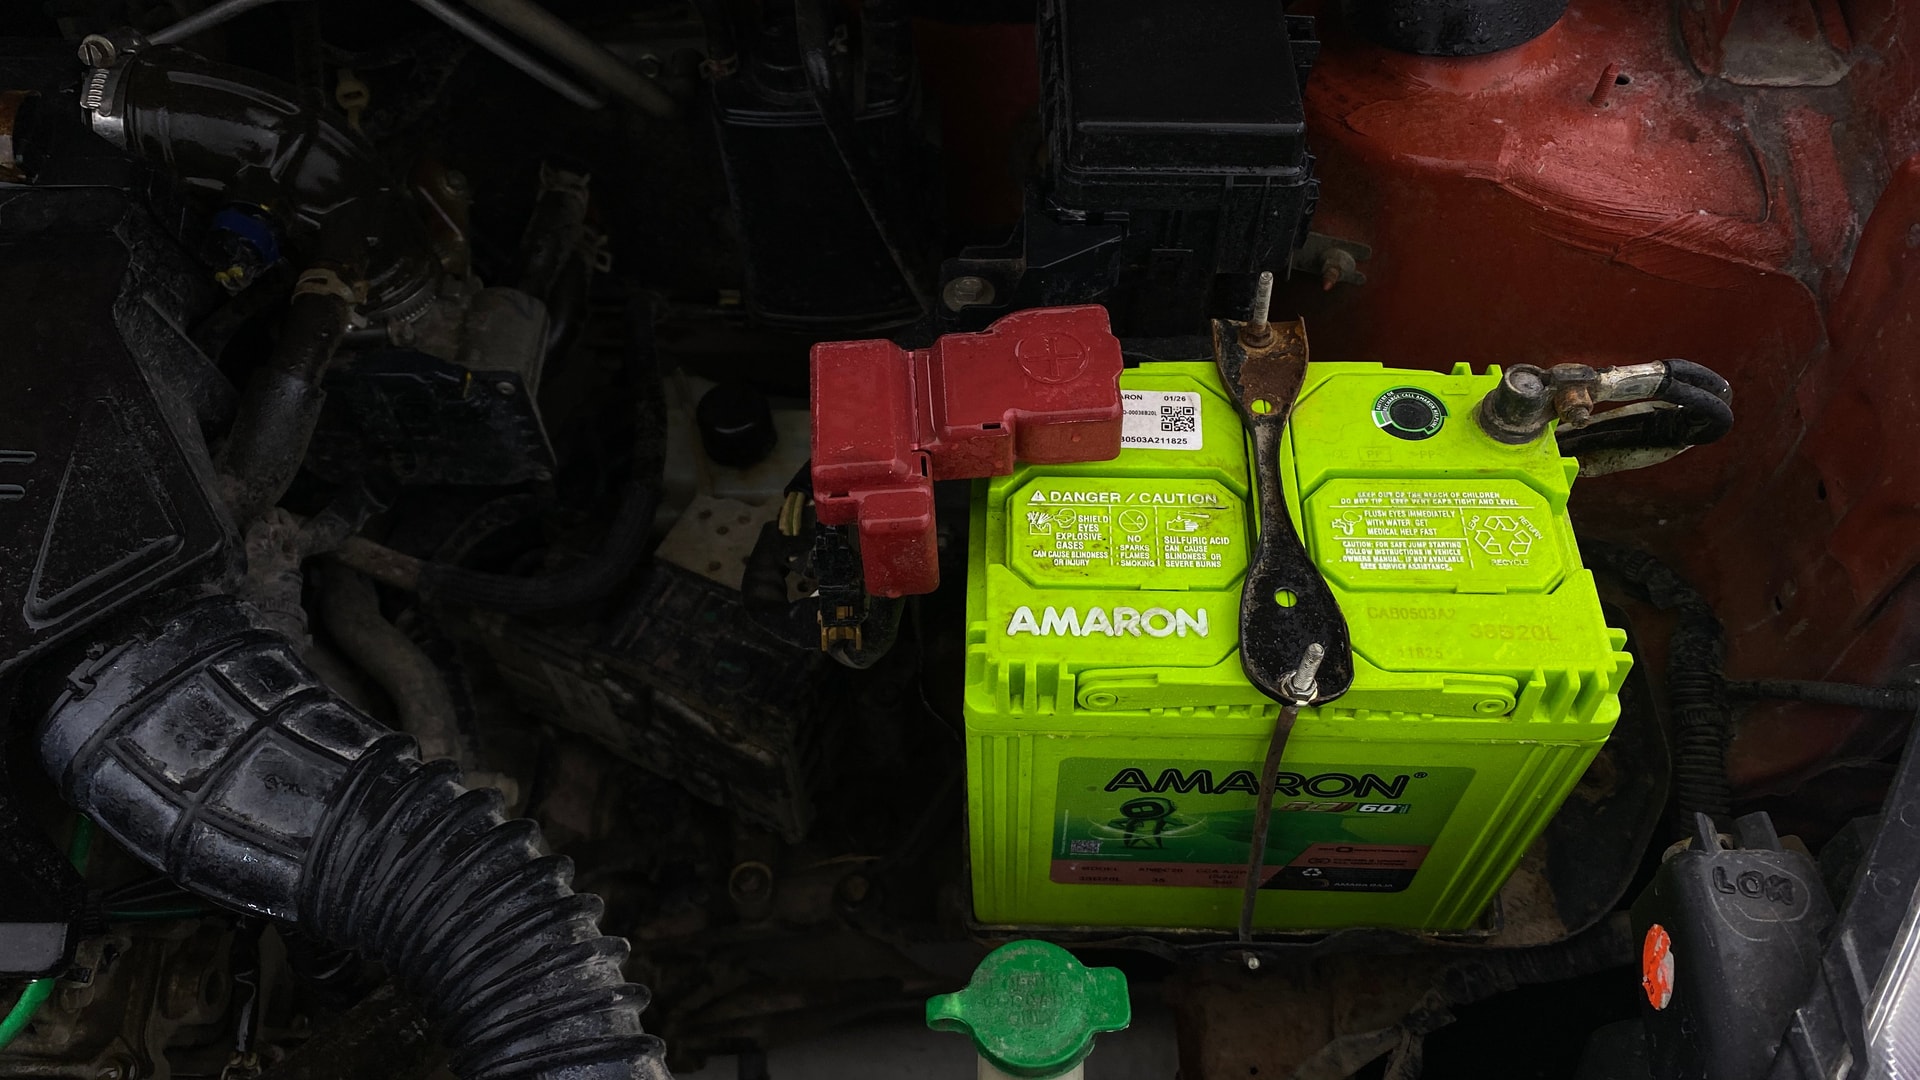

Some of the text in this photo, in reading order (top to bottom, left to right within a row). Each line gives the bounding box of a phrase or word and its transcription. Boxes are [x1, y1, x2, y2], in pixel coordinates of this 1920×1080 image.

[1050, 492, 1121, 503] DANGER
[1139, 493, 1217, 504] CAUTION
[1364, 510, 1455, 518] FLUSH EYES IMMEDIATELY
[1078, 515, 1108, 524] SHIELD
[1366, 519, 1385, 527] WITH
[1415, 519, 1428, 527] GET
[1078, 524, 1099, 532] EYES
[1518, 515, 1544, 540] RETURN
[1367, 528, 1437, 536] MEDICAL HELP FAST
[1056, 533, 1102, 541] EXPLOSIVE
[1127, 535, 1142, 543] NO
[1164, 536, 1230, 545] SULFURIC ACID
[1056, 541, 1084, 550] GASES
[1183, 545, 1208, 553] CAUSE
[1429, 541, 1462, 549] STARTING
[1033, 550, 1108, 559] CAN CAUSE BLINDNESS
[1120, 552, 1150, 560] FLAMES
[1054, 559, 1090, 567] OR INJURY
[1196, 560, 1222, 568] BURNS
[1378, 562, 1406, 570] SERVICE
[1491, 558, 1529, 566] RECYCLE
[1006, 605, 1209, 638] AMARON
[1104, 767, 1410, 799] AMARON
[1358, 803, 1398, 813] 60
